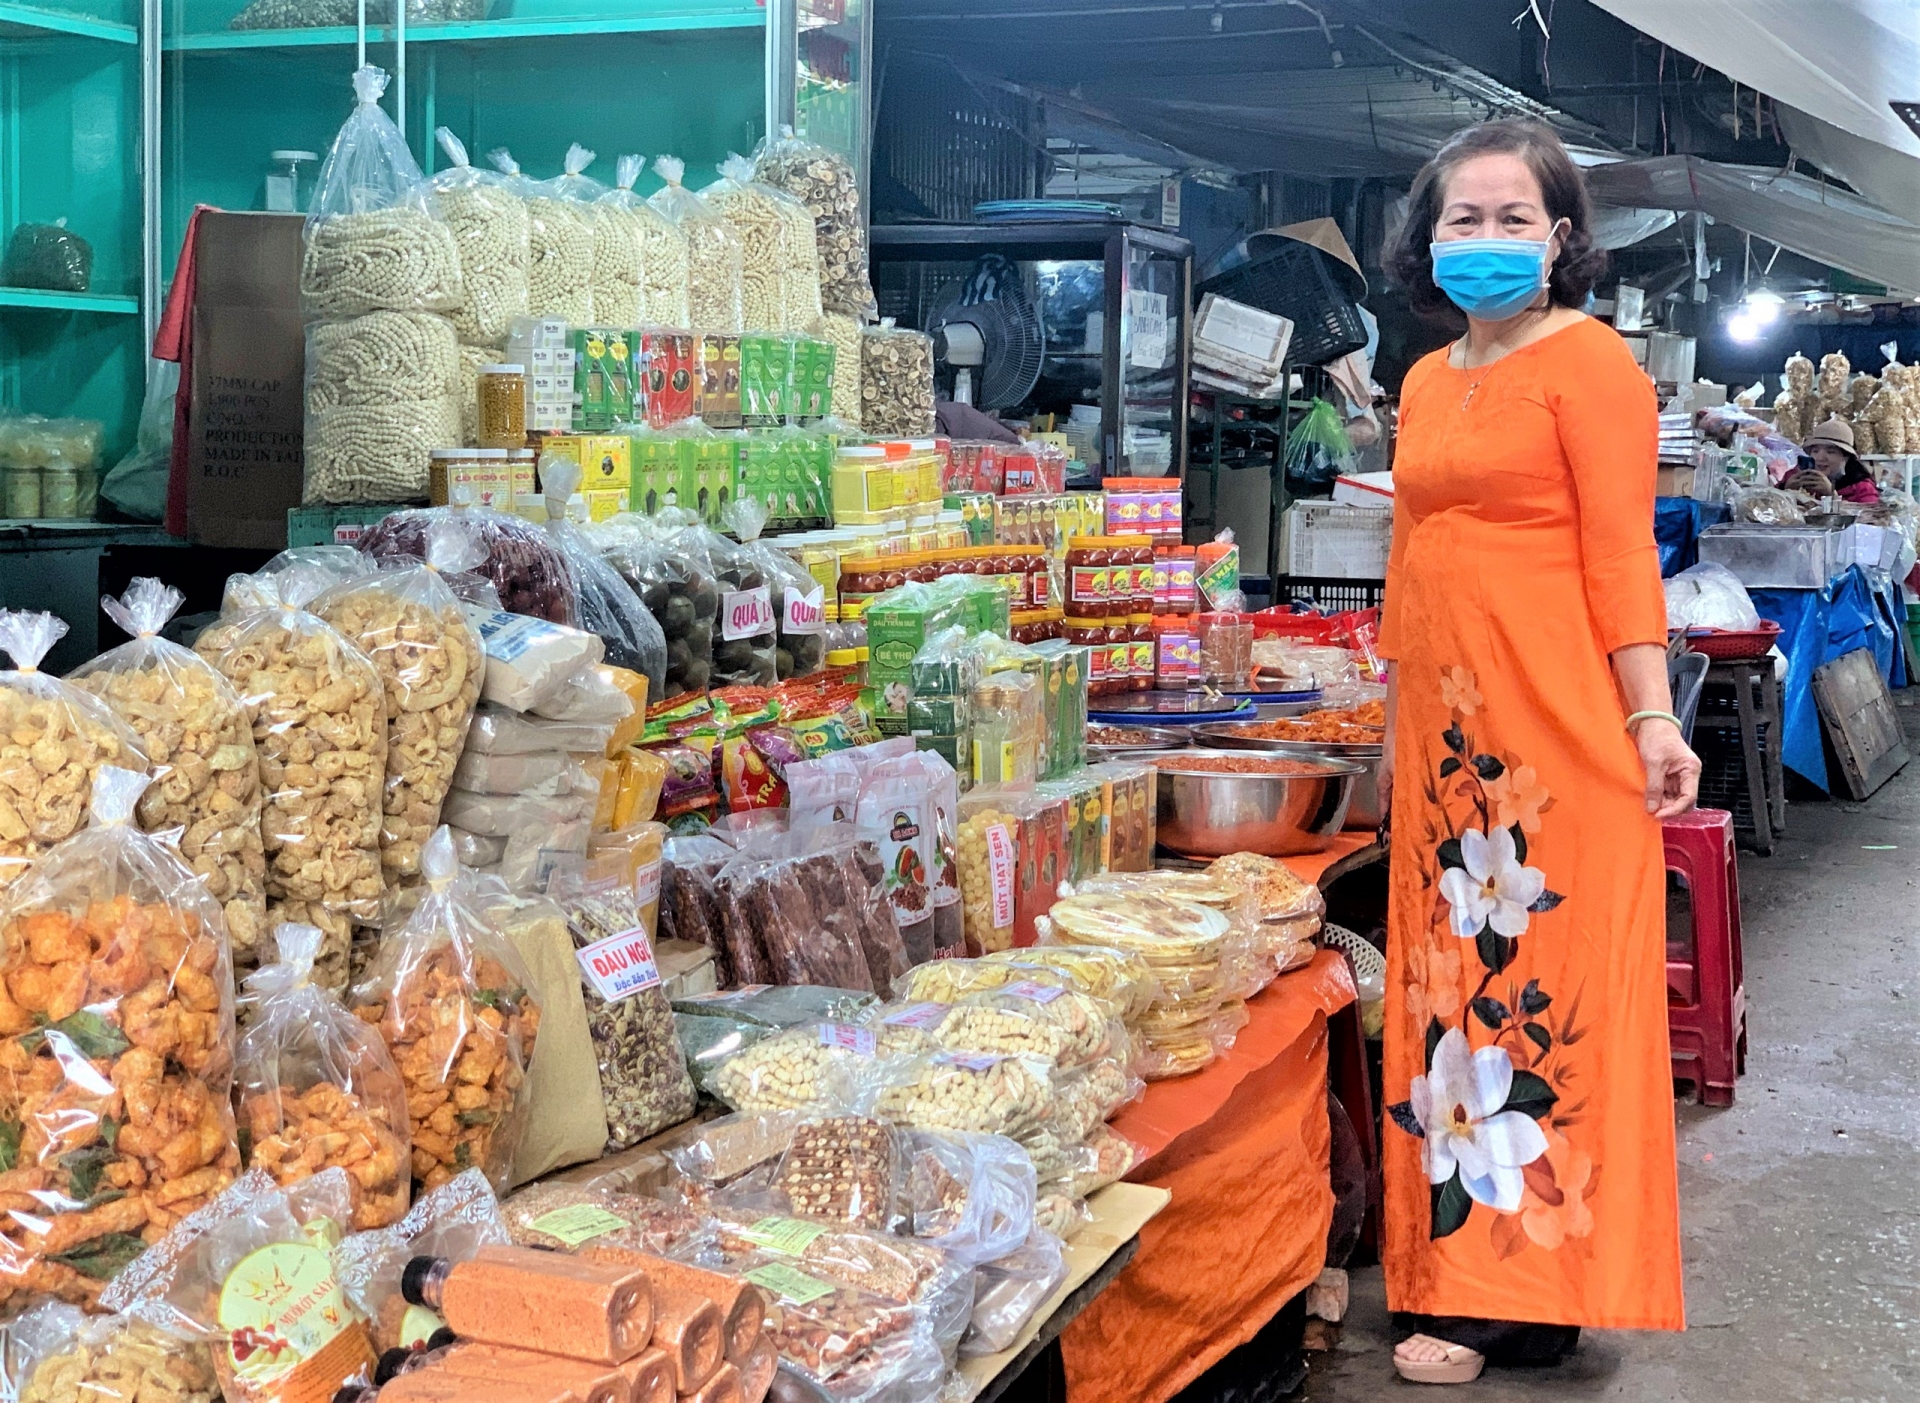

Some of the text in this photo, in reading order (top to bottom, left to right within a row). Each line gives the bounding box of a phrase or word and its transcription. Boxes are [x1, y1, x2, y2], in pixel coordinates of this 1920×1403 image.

[252, 379, 281, 392] CAP
[205, 447, 304, 463] MADE IN TAI
[991, 831, 1004, 859] SEN
[592, 949, 628, 978] ĐẬU
